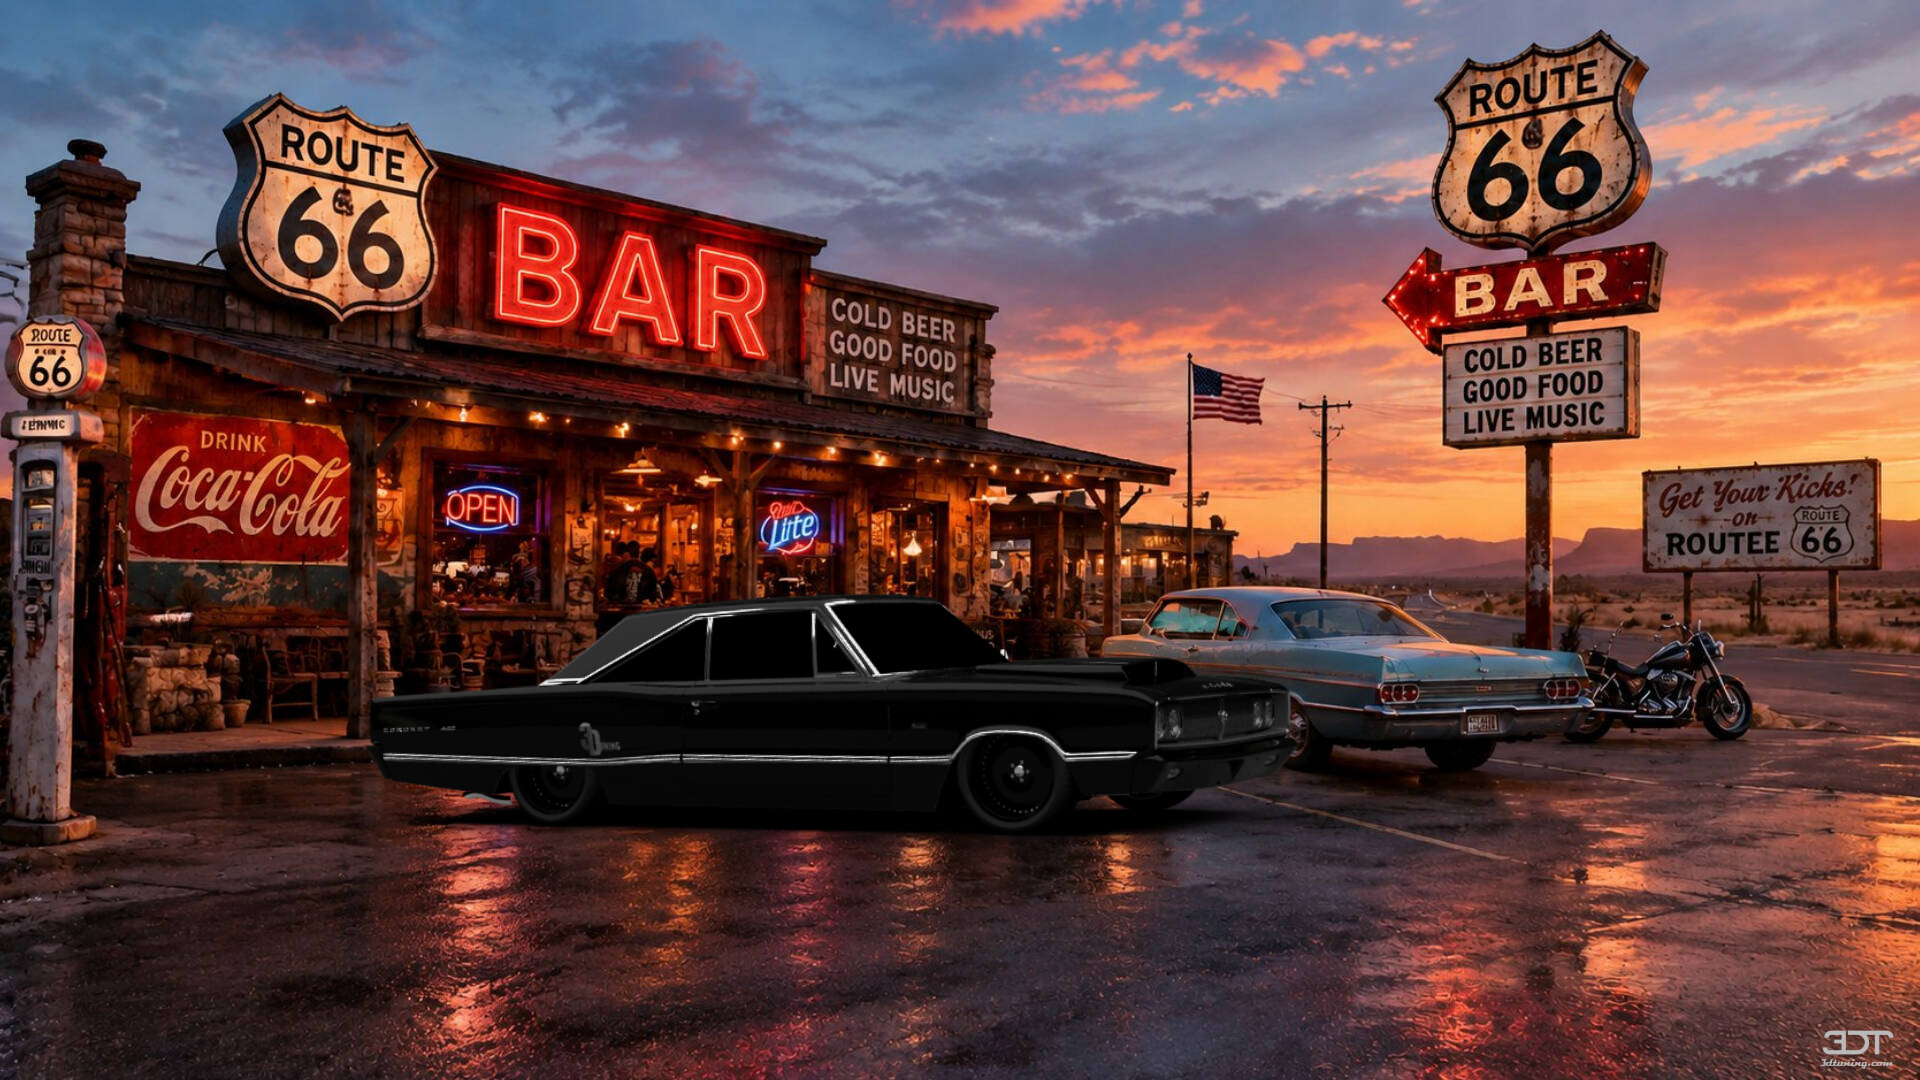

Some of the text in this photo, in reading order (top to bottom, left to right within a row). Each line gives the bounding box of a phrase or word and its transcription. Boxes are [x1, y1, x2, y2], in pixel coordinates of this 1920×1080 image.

[1469, 59, 1599, 117] ROUTE
[280, 123, 405, 183] ROUTE
[1466, 116, 1603, 222] 66
[277, 186, 406, 290] 66
[494, 202, 769, 360] BAR
[1454, 259, 1609, 318] BAR
[31, 328, 72, 342] ROUTE
[831, 298, 956, 343] COLD BEER
[29, 355, 72, 387] 66
[829, 330, 957, 373] GOOD FOOD
[1464, 337, 1603, 374] COLD BEER
[830, 363, 955, 404] LIVE MUSIC
[1463, 370, 1603, 404] GOOD FOOD
[1463, 401, 1605, 434] LIVE MUSIC
[200, 430, 266, 452] DRINK
[135, 445, 351, 537] Coca-Cola
[447, 493, 515, 524] OPEN
[1658, 471, 1858, 518] Get Your Kicks!
[768, 514, 815, 550] Lite
[1802, 510, 1840, 521] ROUTE
[1665, 530, 1780, 556] ROUTEE
[1801, 526, 1842, 553] 66
